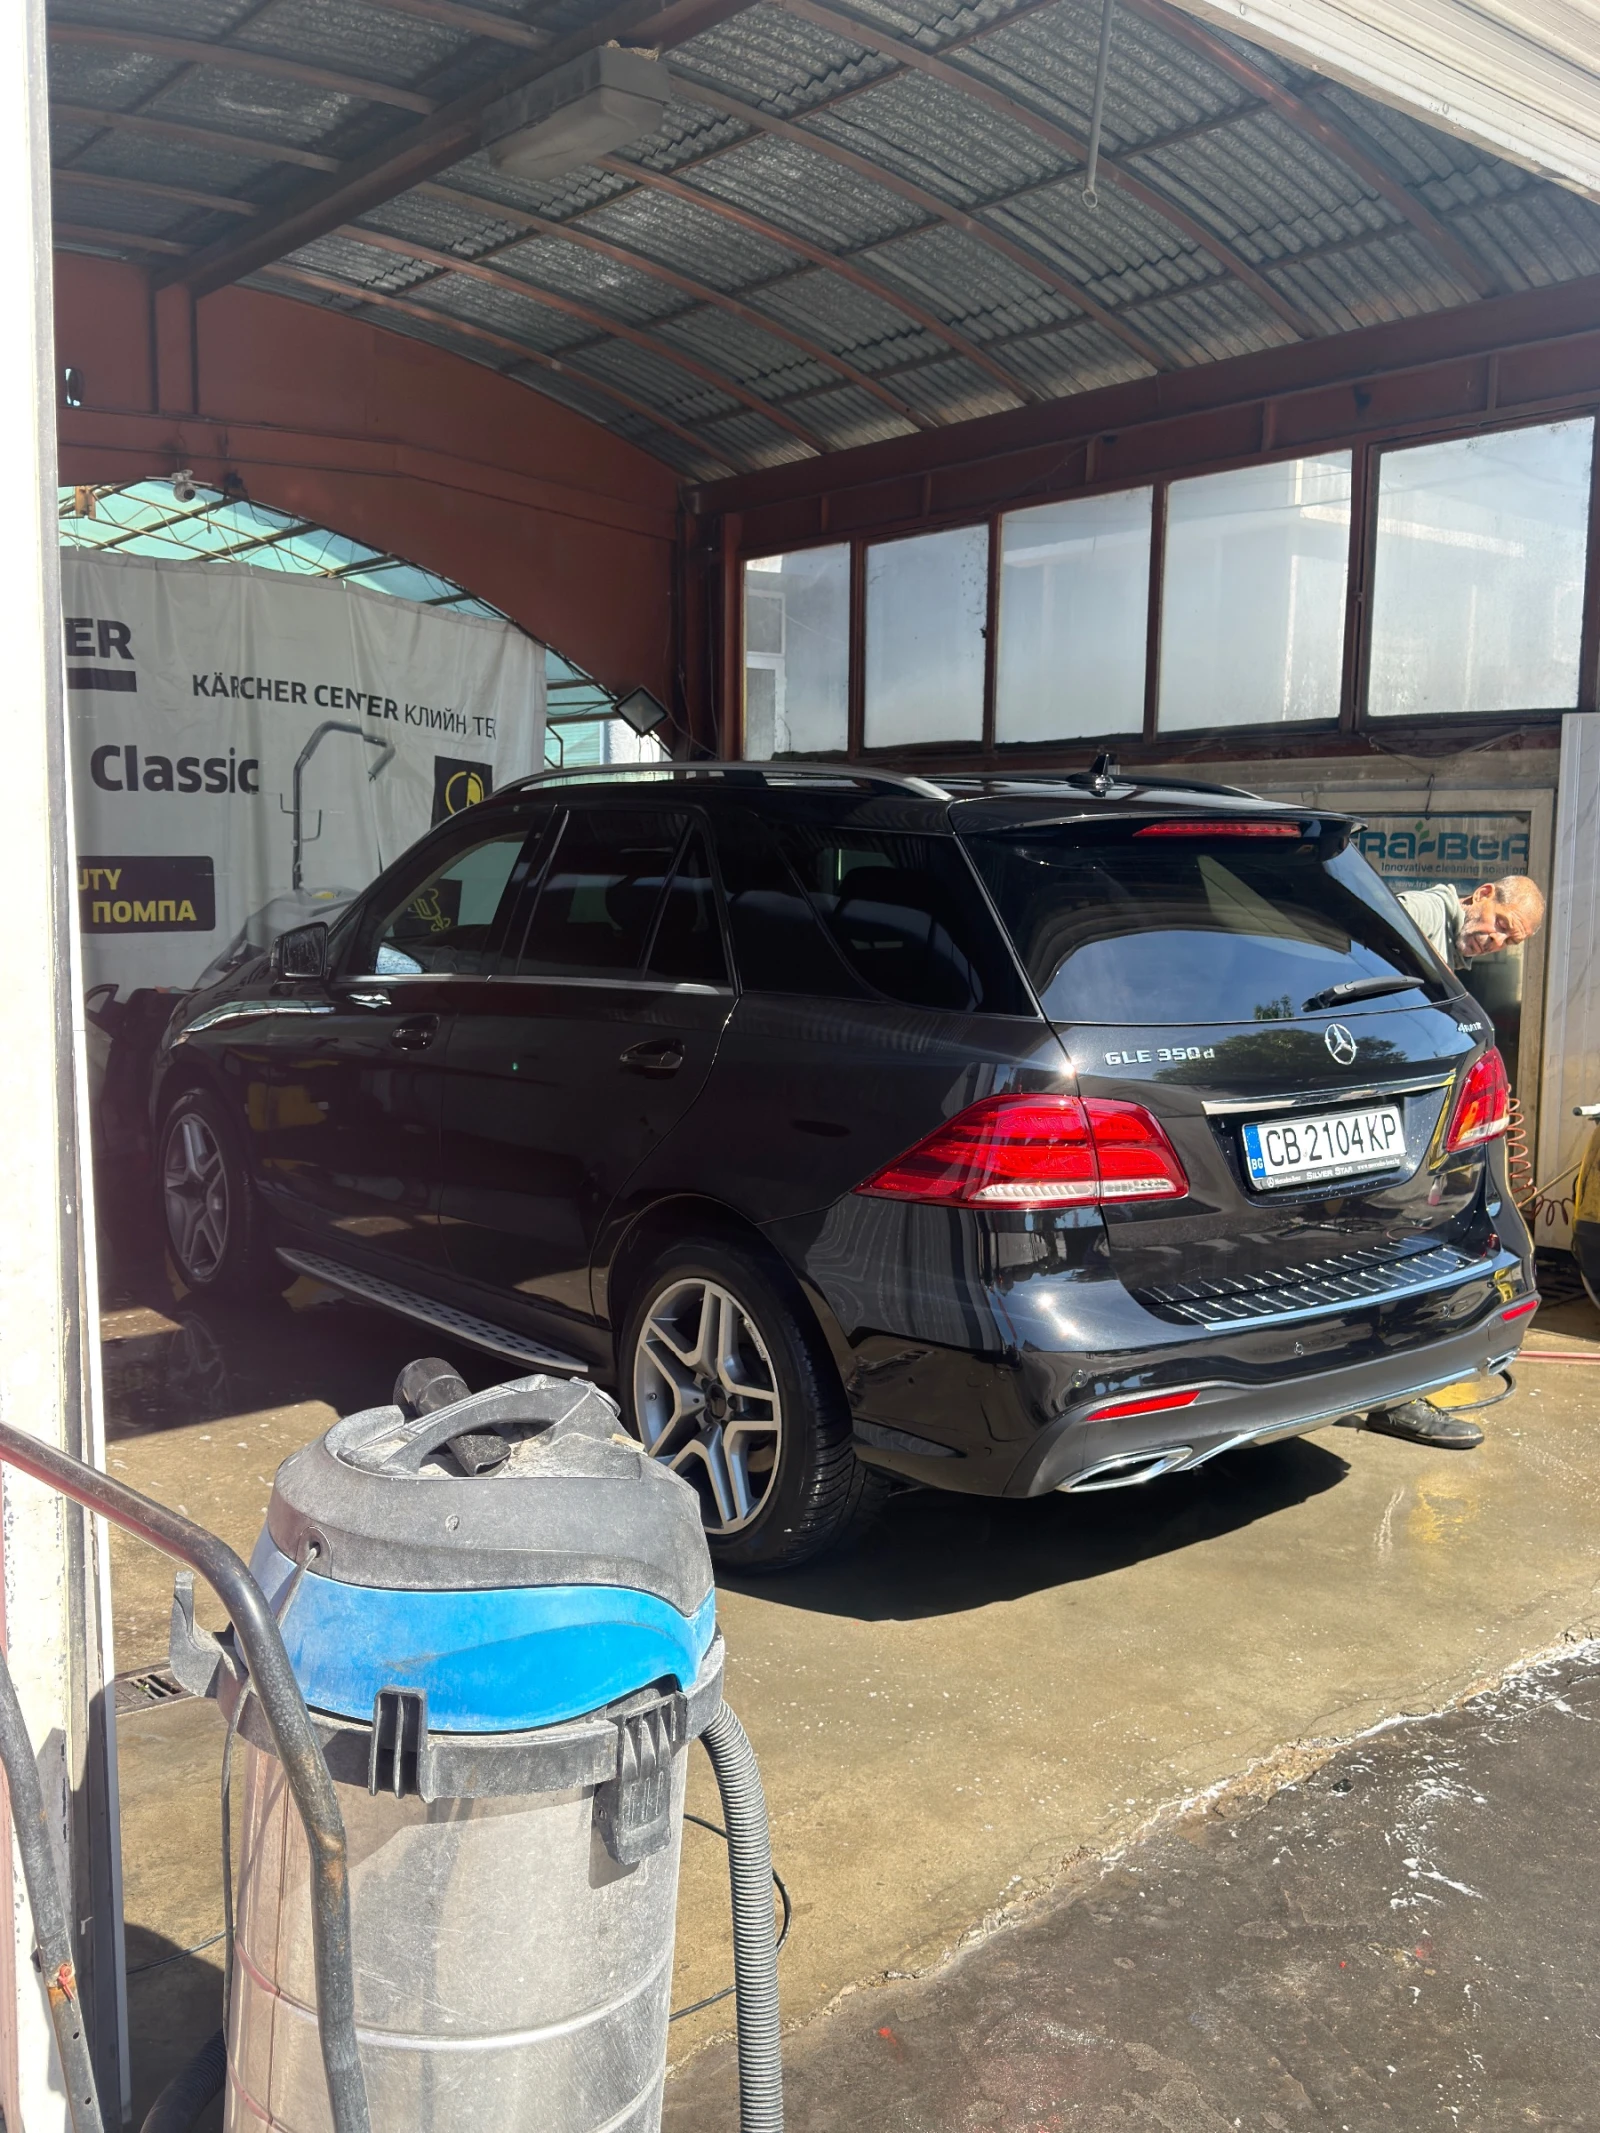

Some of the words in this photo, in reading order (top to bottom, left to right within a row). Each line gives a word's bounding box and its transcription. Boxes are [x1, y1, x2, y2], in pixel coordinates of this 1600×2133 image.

[192, 671, 308, 705] KÄRCHER
[314, 684, 399, 721] CENTER
[404, 703, 467, 735] КЛИЙН
[472, 716, 497, 740] ТЕ
[90, 744, 260, 795] Classic
[1381, 862, 1433, 873] Innovative
[1435, 863, 1479, 876] cleaning
[92, 900, 198, 924] ПОМПА
[1104, 1049, 1152, 1066] GLE
[1251, 1157, 1264, 1170] BG
[1306, 1168, 1333, 1181] SILVER
[1334, 1165, 1353, 1175] STAR
